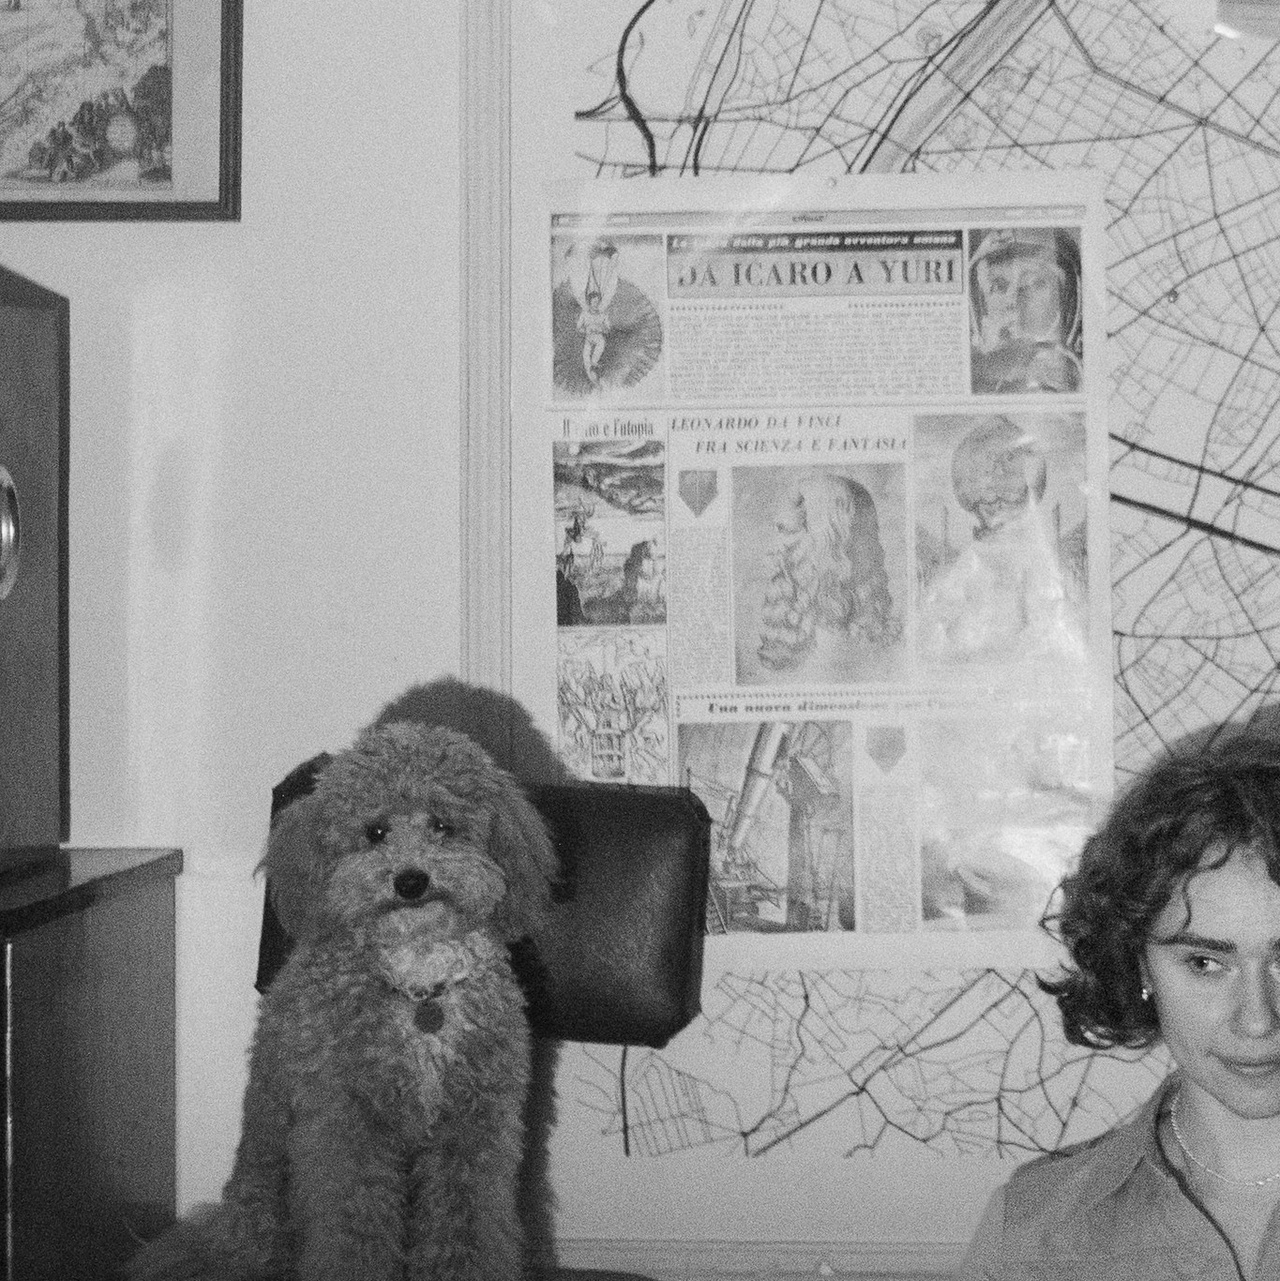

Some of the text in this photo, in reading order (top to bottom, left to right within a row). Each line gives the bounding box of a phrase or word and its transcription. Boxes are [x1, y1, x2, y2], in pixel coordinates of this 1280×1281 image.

[794, 233, 841, 249] grande
[843, 232, 910, 246] avventura
[732, 260, 833, 287] ICARO
[846, 260, 865, 286] A
[878, 257, 956, 285] YURI
[603, 423, 610, 437] e
[613, 417, 654, 439] l'utopia
[671, 414, 842, 431] LEONARDO DA VINCI
[695, 437, 910, 454] FRA SCIENZA E FANTASIA
[744, 703, 792, 713] nuova
